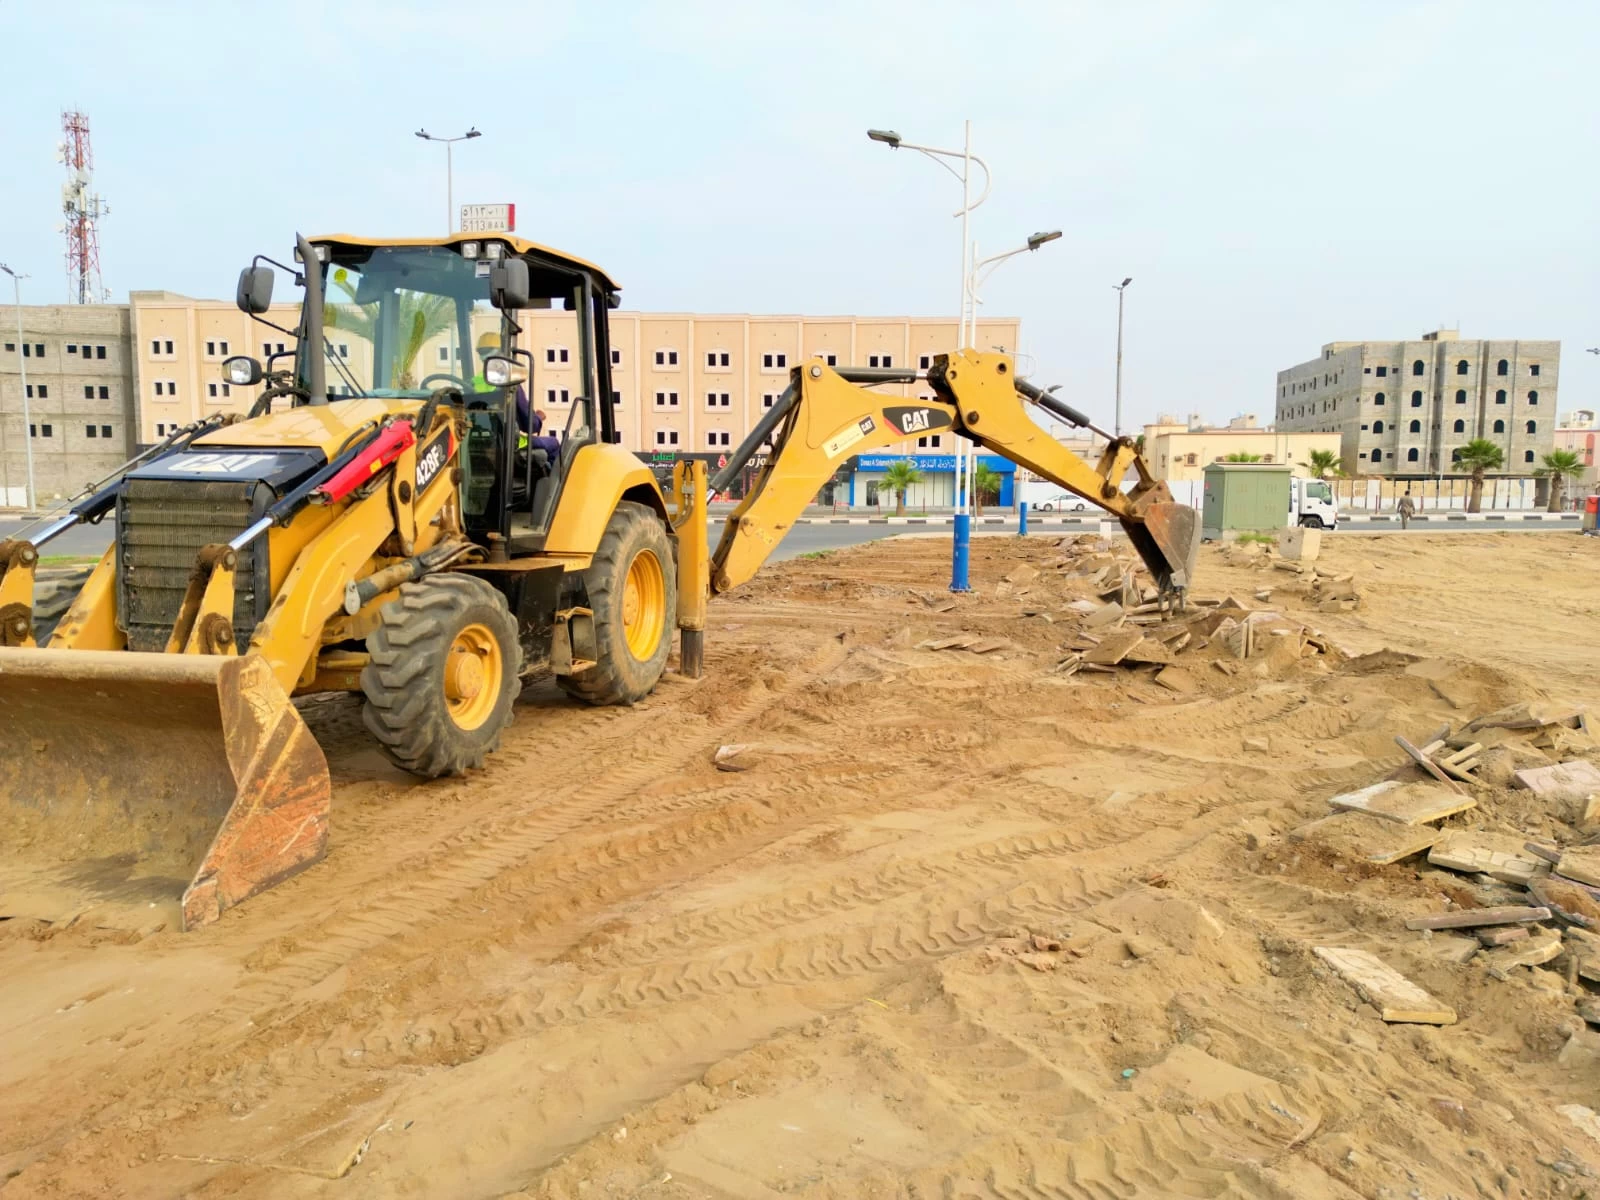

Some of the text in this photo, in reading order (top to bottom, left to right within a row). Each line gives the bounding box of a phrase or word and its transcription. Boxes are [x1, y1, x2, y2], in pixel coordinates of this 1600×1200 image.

[463, 220, 486, 232] 5113
[902, 409, 930, 433] CAT
[168, 454, 278, 473] CAT
